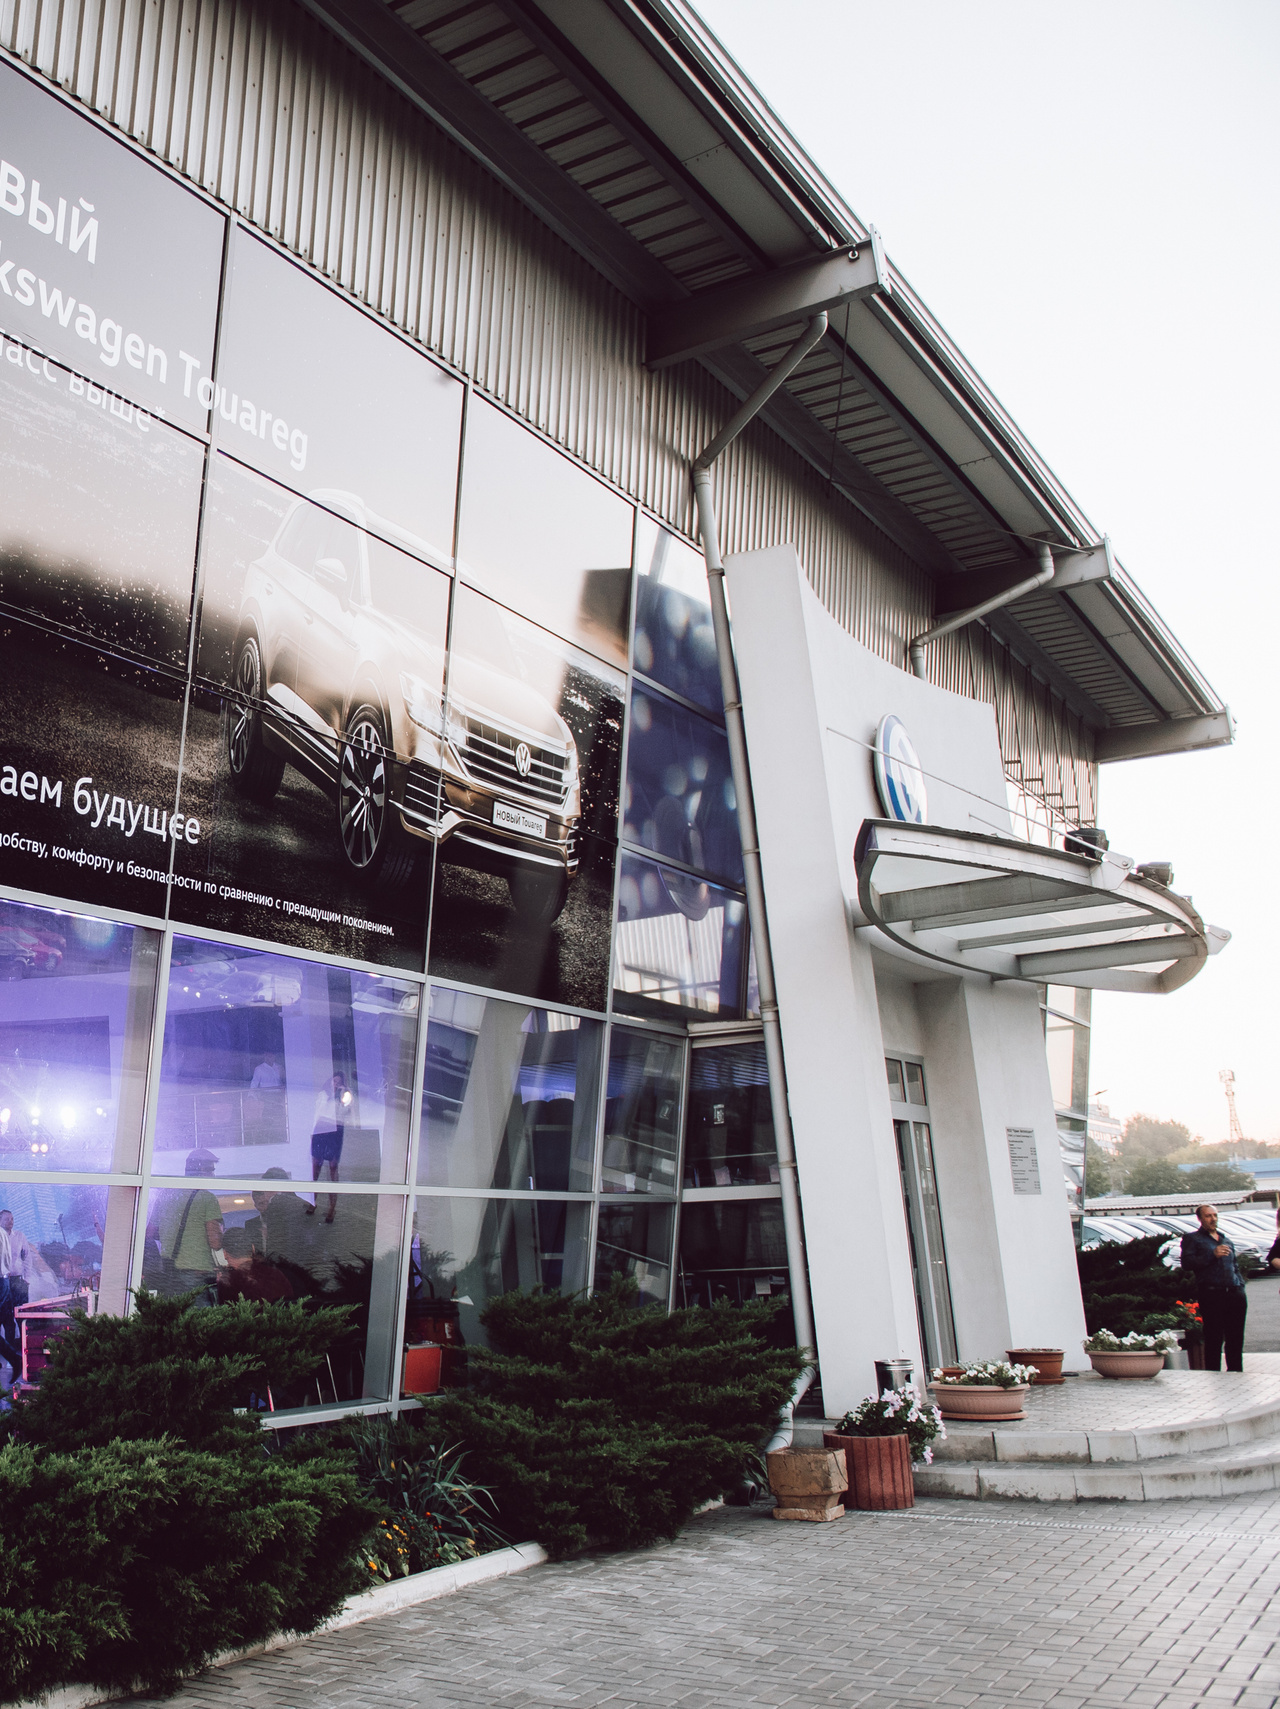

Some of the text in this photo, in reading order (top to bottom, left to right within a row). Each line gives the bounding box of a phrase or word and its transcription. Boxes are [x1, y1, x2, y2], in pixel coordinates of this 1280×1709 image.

[179, 349, 309, 471] Touareg
[73, 776, 201, 846] будущее
[496, 808, 543, 834] НОВЫЙ Touareg
[52, 845, 114, 874] комфорту
[116, 861, 124, 873] и
[204, 882, 217, 894] по
[219, 884, 273, 907] сравнению
[275, 898, 281, 910] с
[283, 900, 341, 924] предыдущим
[342, 915, 395, 937] поколением.
